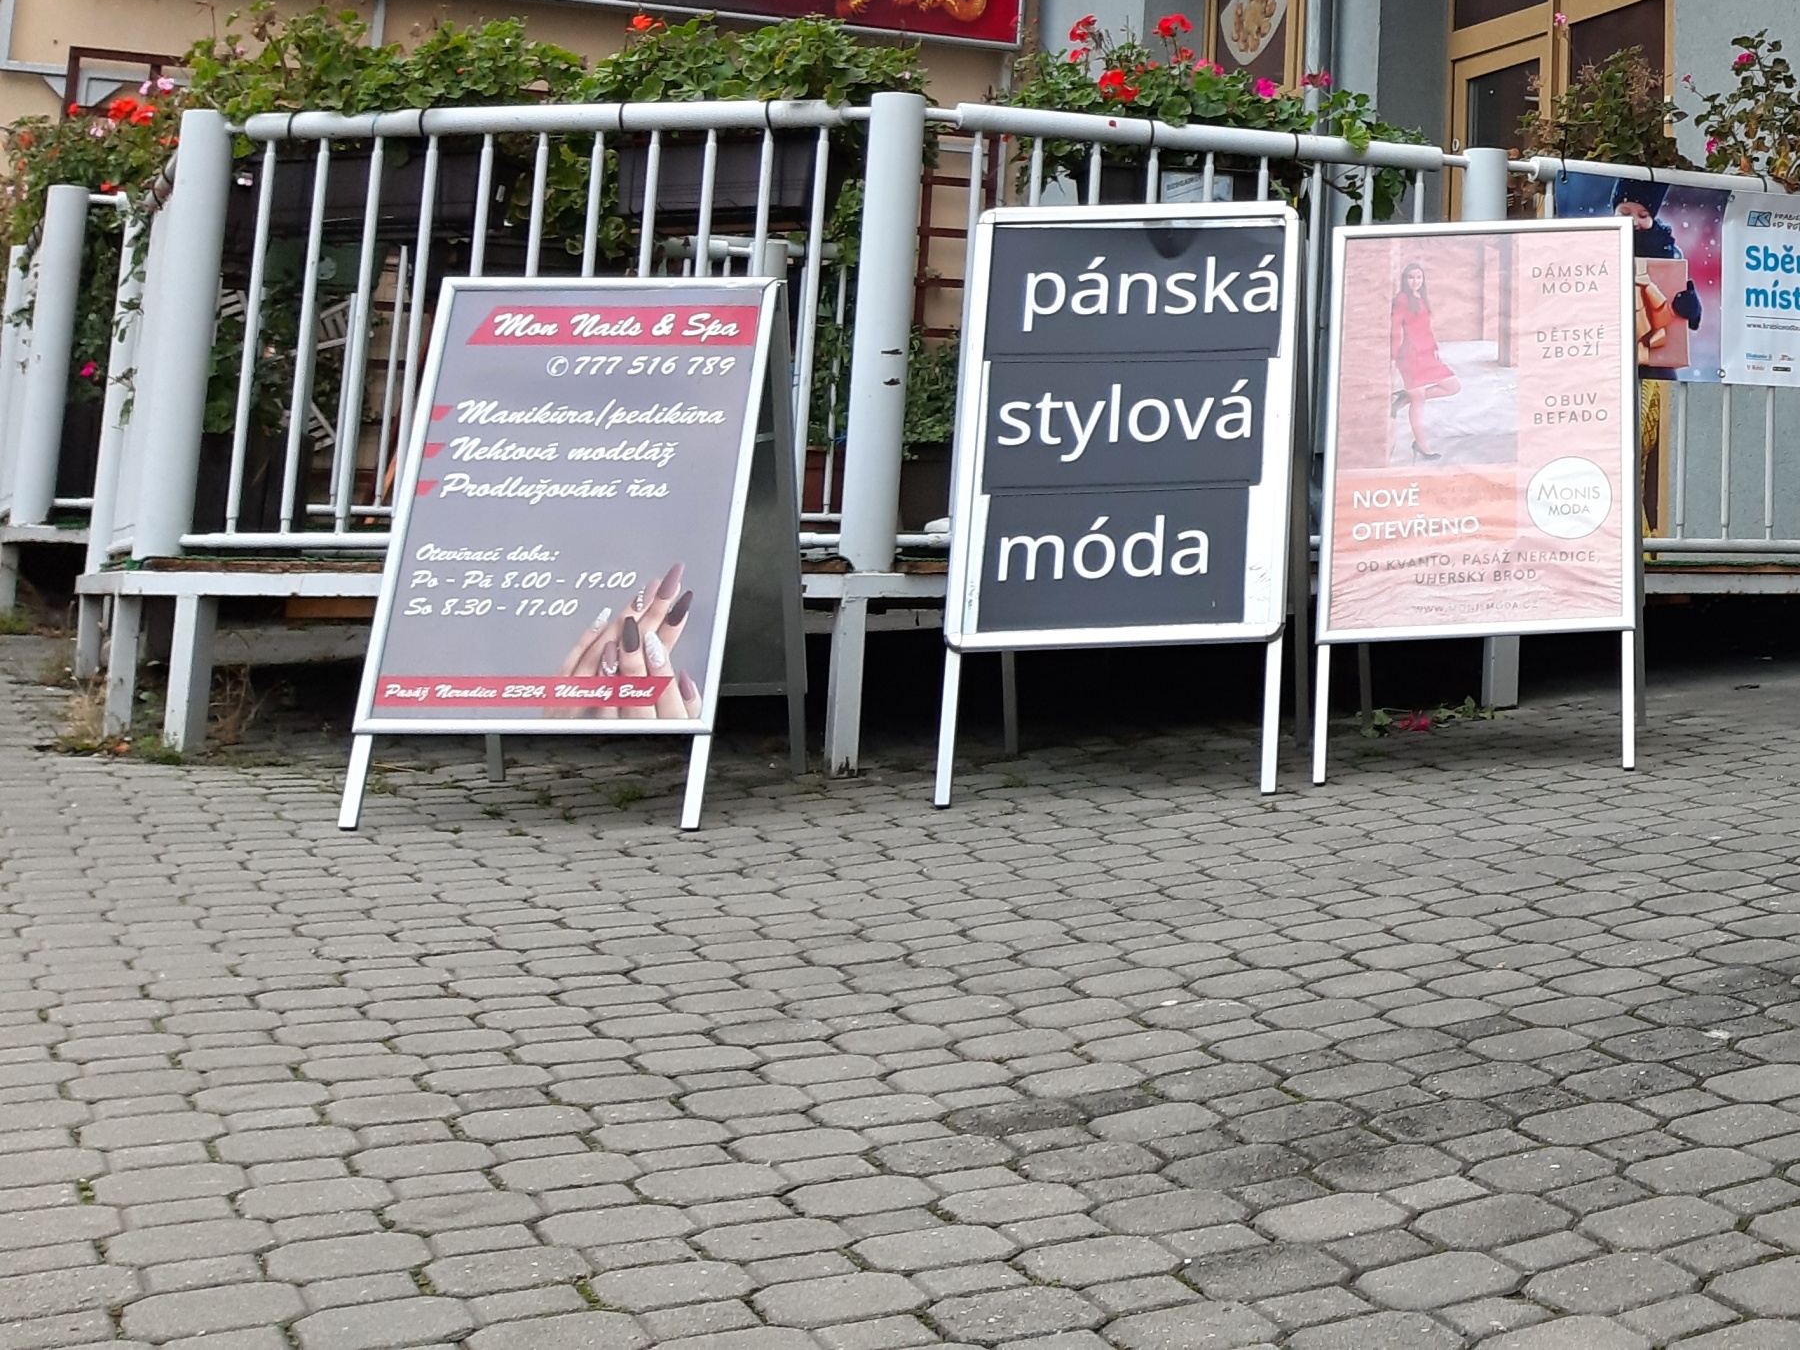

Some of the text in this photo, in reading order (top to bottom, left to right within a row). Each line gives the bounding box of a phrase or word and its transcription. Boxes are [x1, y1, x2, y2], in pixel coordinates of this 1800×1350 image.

[1532, 261, 1610, 279] DÁMSKÁ
[1022, 253, 1279, 333] pánská
[1542, 278, 1600, 294] MÓDA
[493, 311, 741, 341] Mon Nails & Spa
[1536, 326, 1605, 343] DĚTSKÉ
[1542, 340, 1600, 359] ZBOŽÍ
[573, 356, 737, 376] 777 516 789
[1544, 391, 1598, 407] OBUV
[456, 399, 726, 431] Manikúra/pedikúra
[997, 378, 1252, 463] stylová
[1534, 408, 1609, 425] BEFADO
[449, 436, 677, 469] Nehtová modeláž
[440, 473, 670, 506] Prodlužování řas
[1352, 481, 1421, 510] NOVĚ
[1548, 500, 1591, 517] MÓDA
[1352, 514, 1480, 541] OTEVŘENO
[415, 542, 560, 563] Otevírací doba:
[997, 514, 1209, 582] móda
[1356, 549, 1601, 573] OD KVANTO, PASÁŽ NERADICE,
[410, 571, 440, 589] Po
[462, 571, 493, 589] Pá
[501, 571, 553, 590] 8.00
[574, 571, 637, 590] 19.00
[1415, 567, 1537, 584] UHERSKÝ BROD
[404, 597, 434, 617] So
[440, 598, 491, 617] 8.30
[515, 598, 578, 617] 17.00
[384, 683, 430, 701] Pasáž
[434, 684, 498, 699] Neradice
[554, 684, 613, 701] Uherský
[618, 684, 654, 699] Brod
